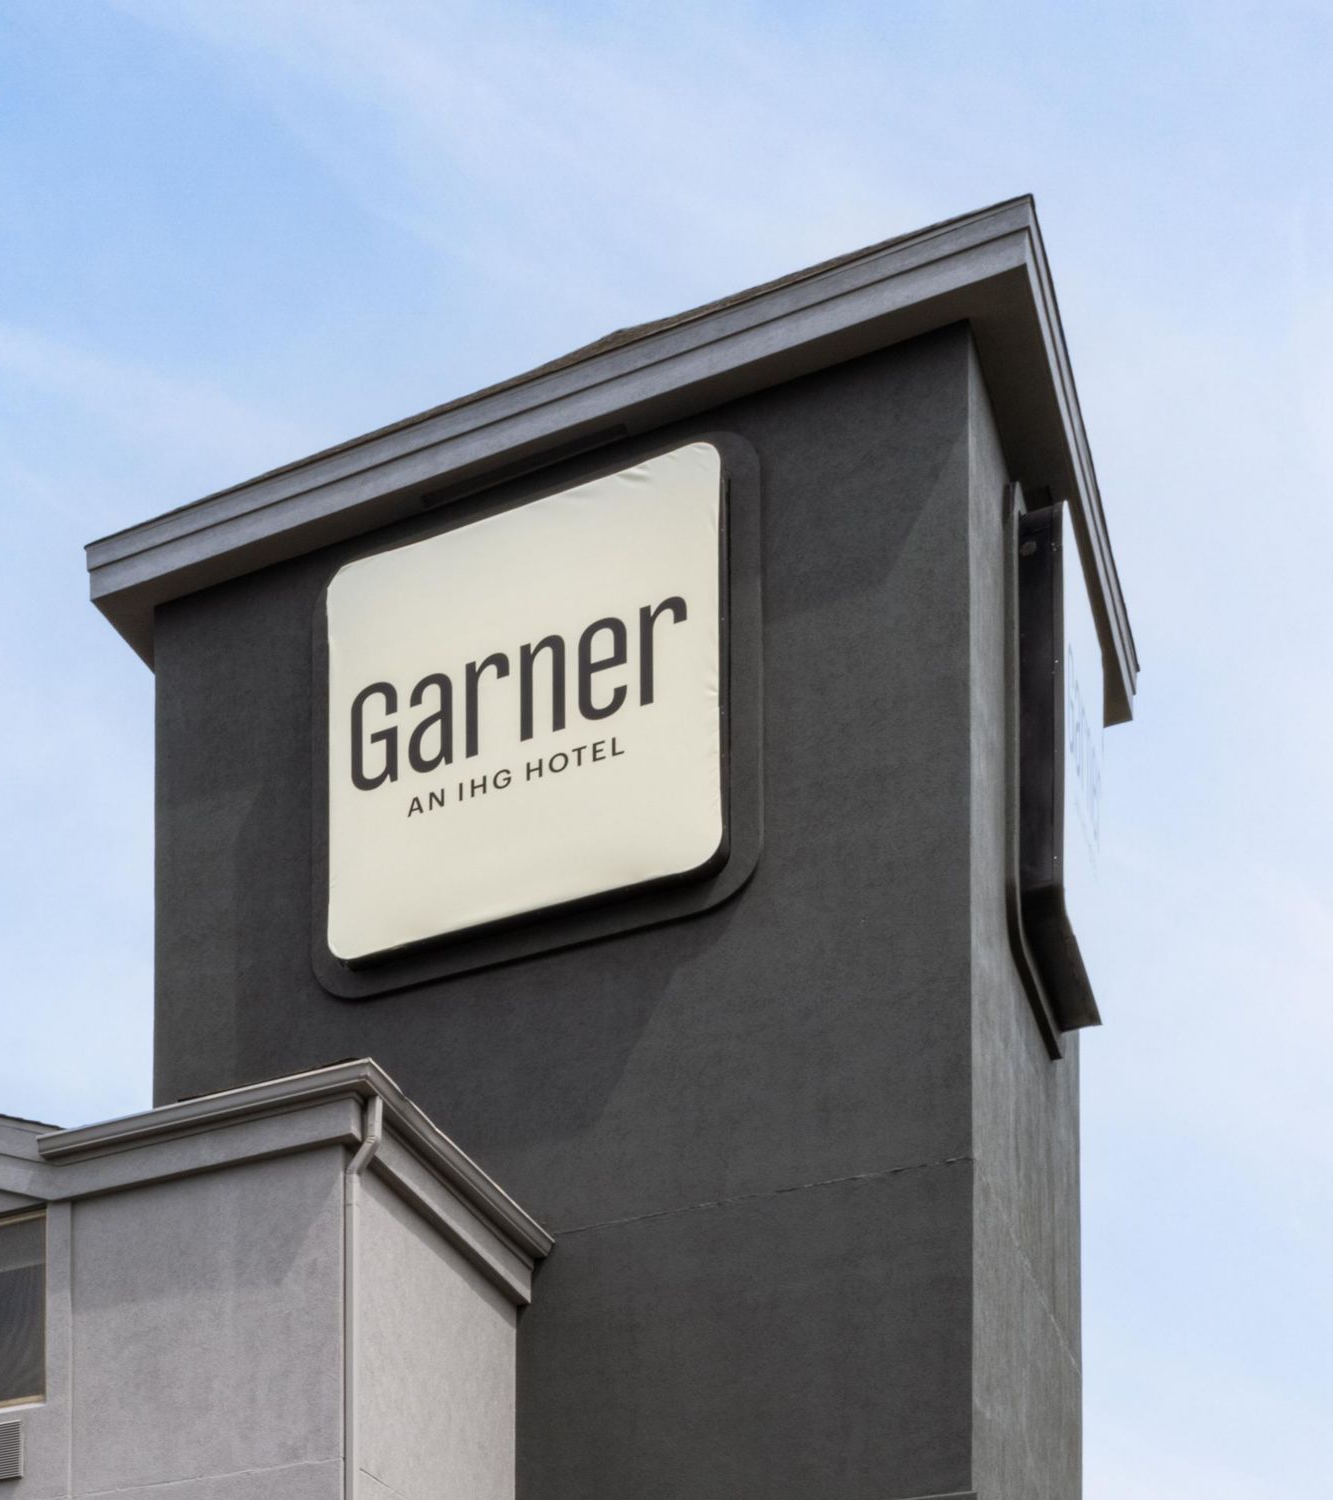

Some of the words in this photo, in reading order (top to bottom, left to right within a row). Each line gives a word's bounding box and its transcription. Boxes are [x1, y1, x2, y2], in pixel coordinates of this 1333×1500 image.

[350, 596, 688, 791] Garner
[407, 788, 446, 818] AN
[458, 768, 513, 802] IHG
[526, 737, 625, 781] HOTEL
